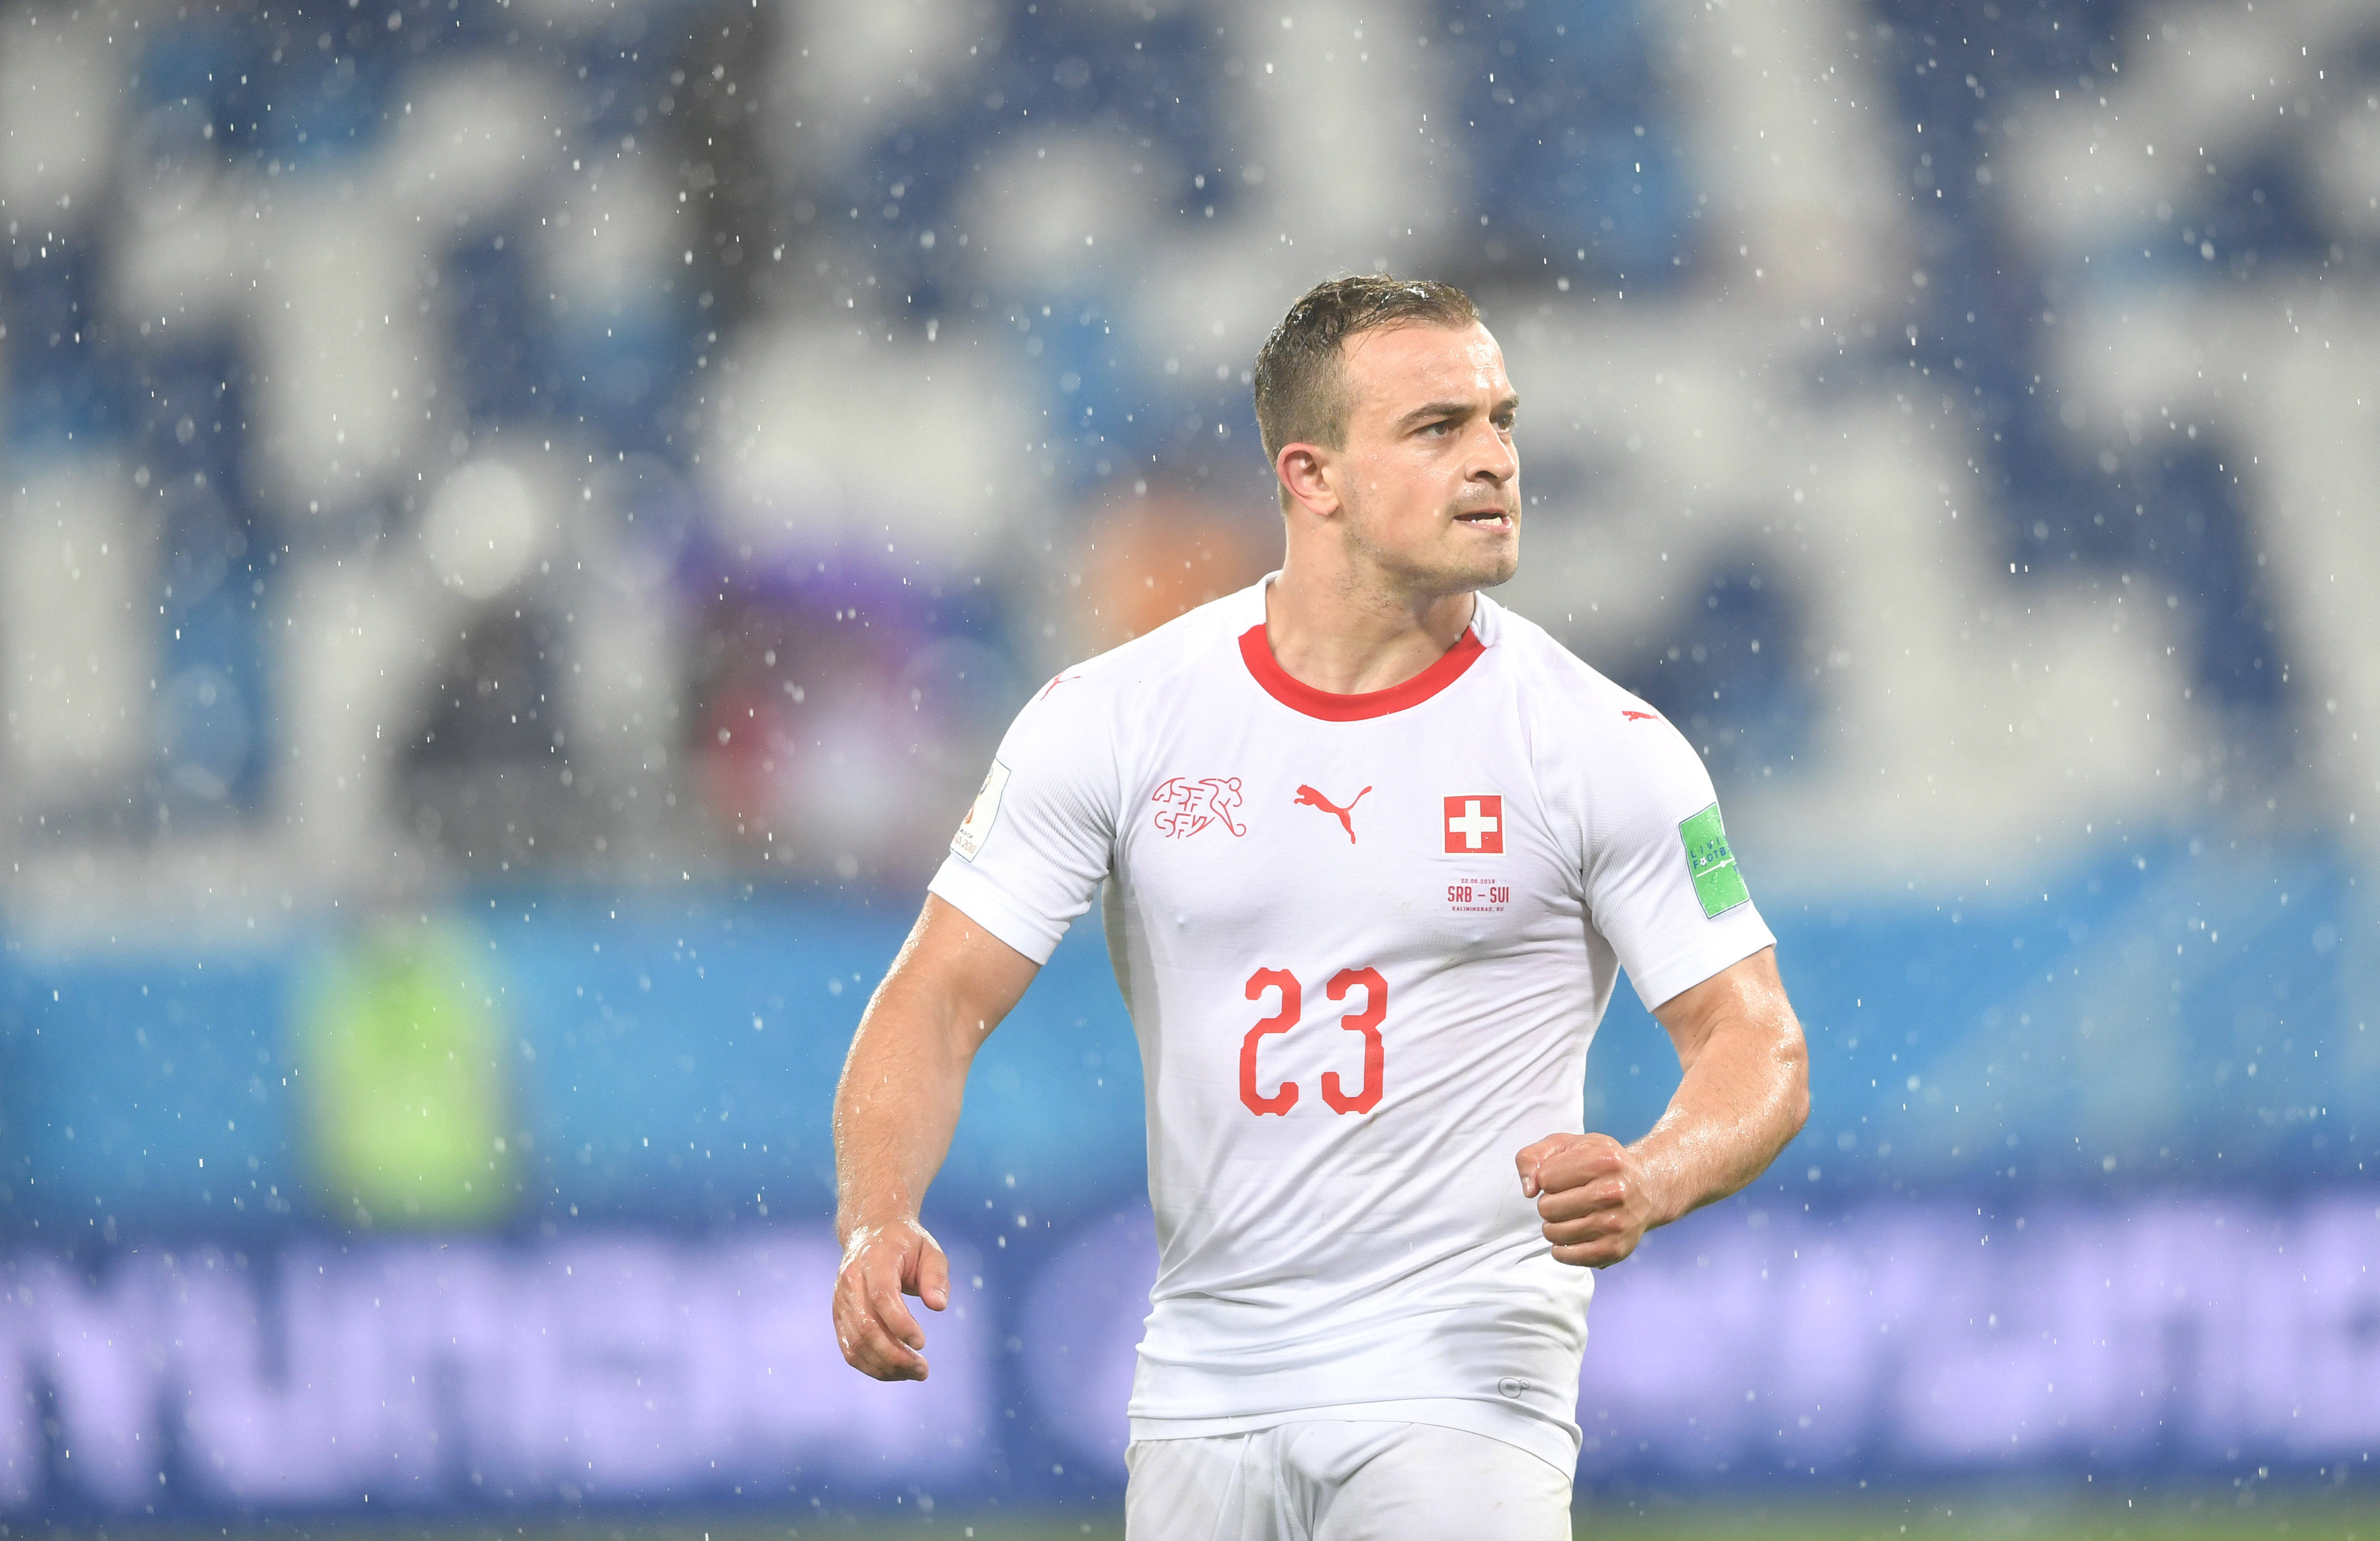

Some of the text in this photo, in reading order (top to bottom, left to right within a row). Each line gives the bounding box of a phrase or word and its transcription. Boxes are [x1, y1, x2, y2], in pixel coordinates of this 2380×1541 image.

[961, 839, 977, 853] 2018
[1448, 885, 1472, 903] SRB
[1490, 886, 1509, 903] SUI
[1239, 967, 1388, 1116] 23
